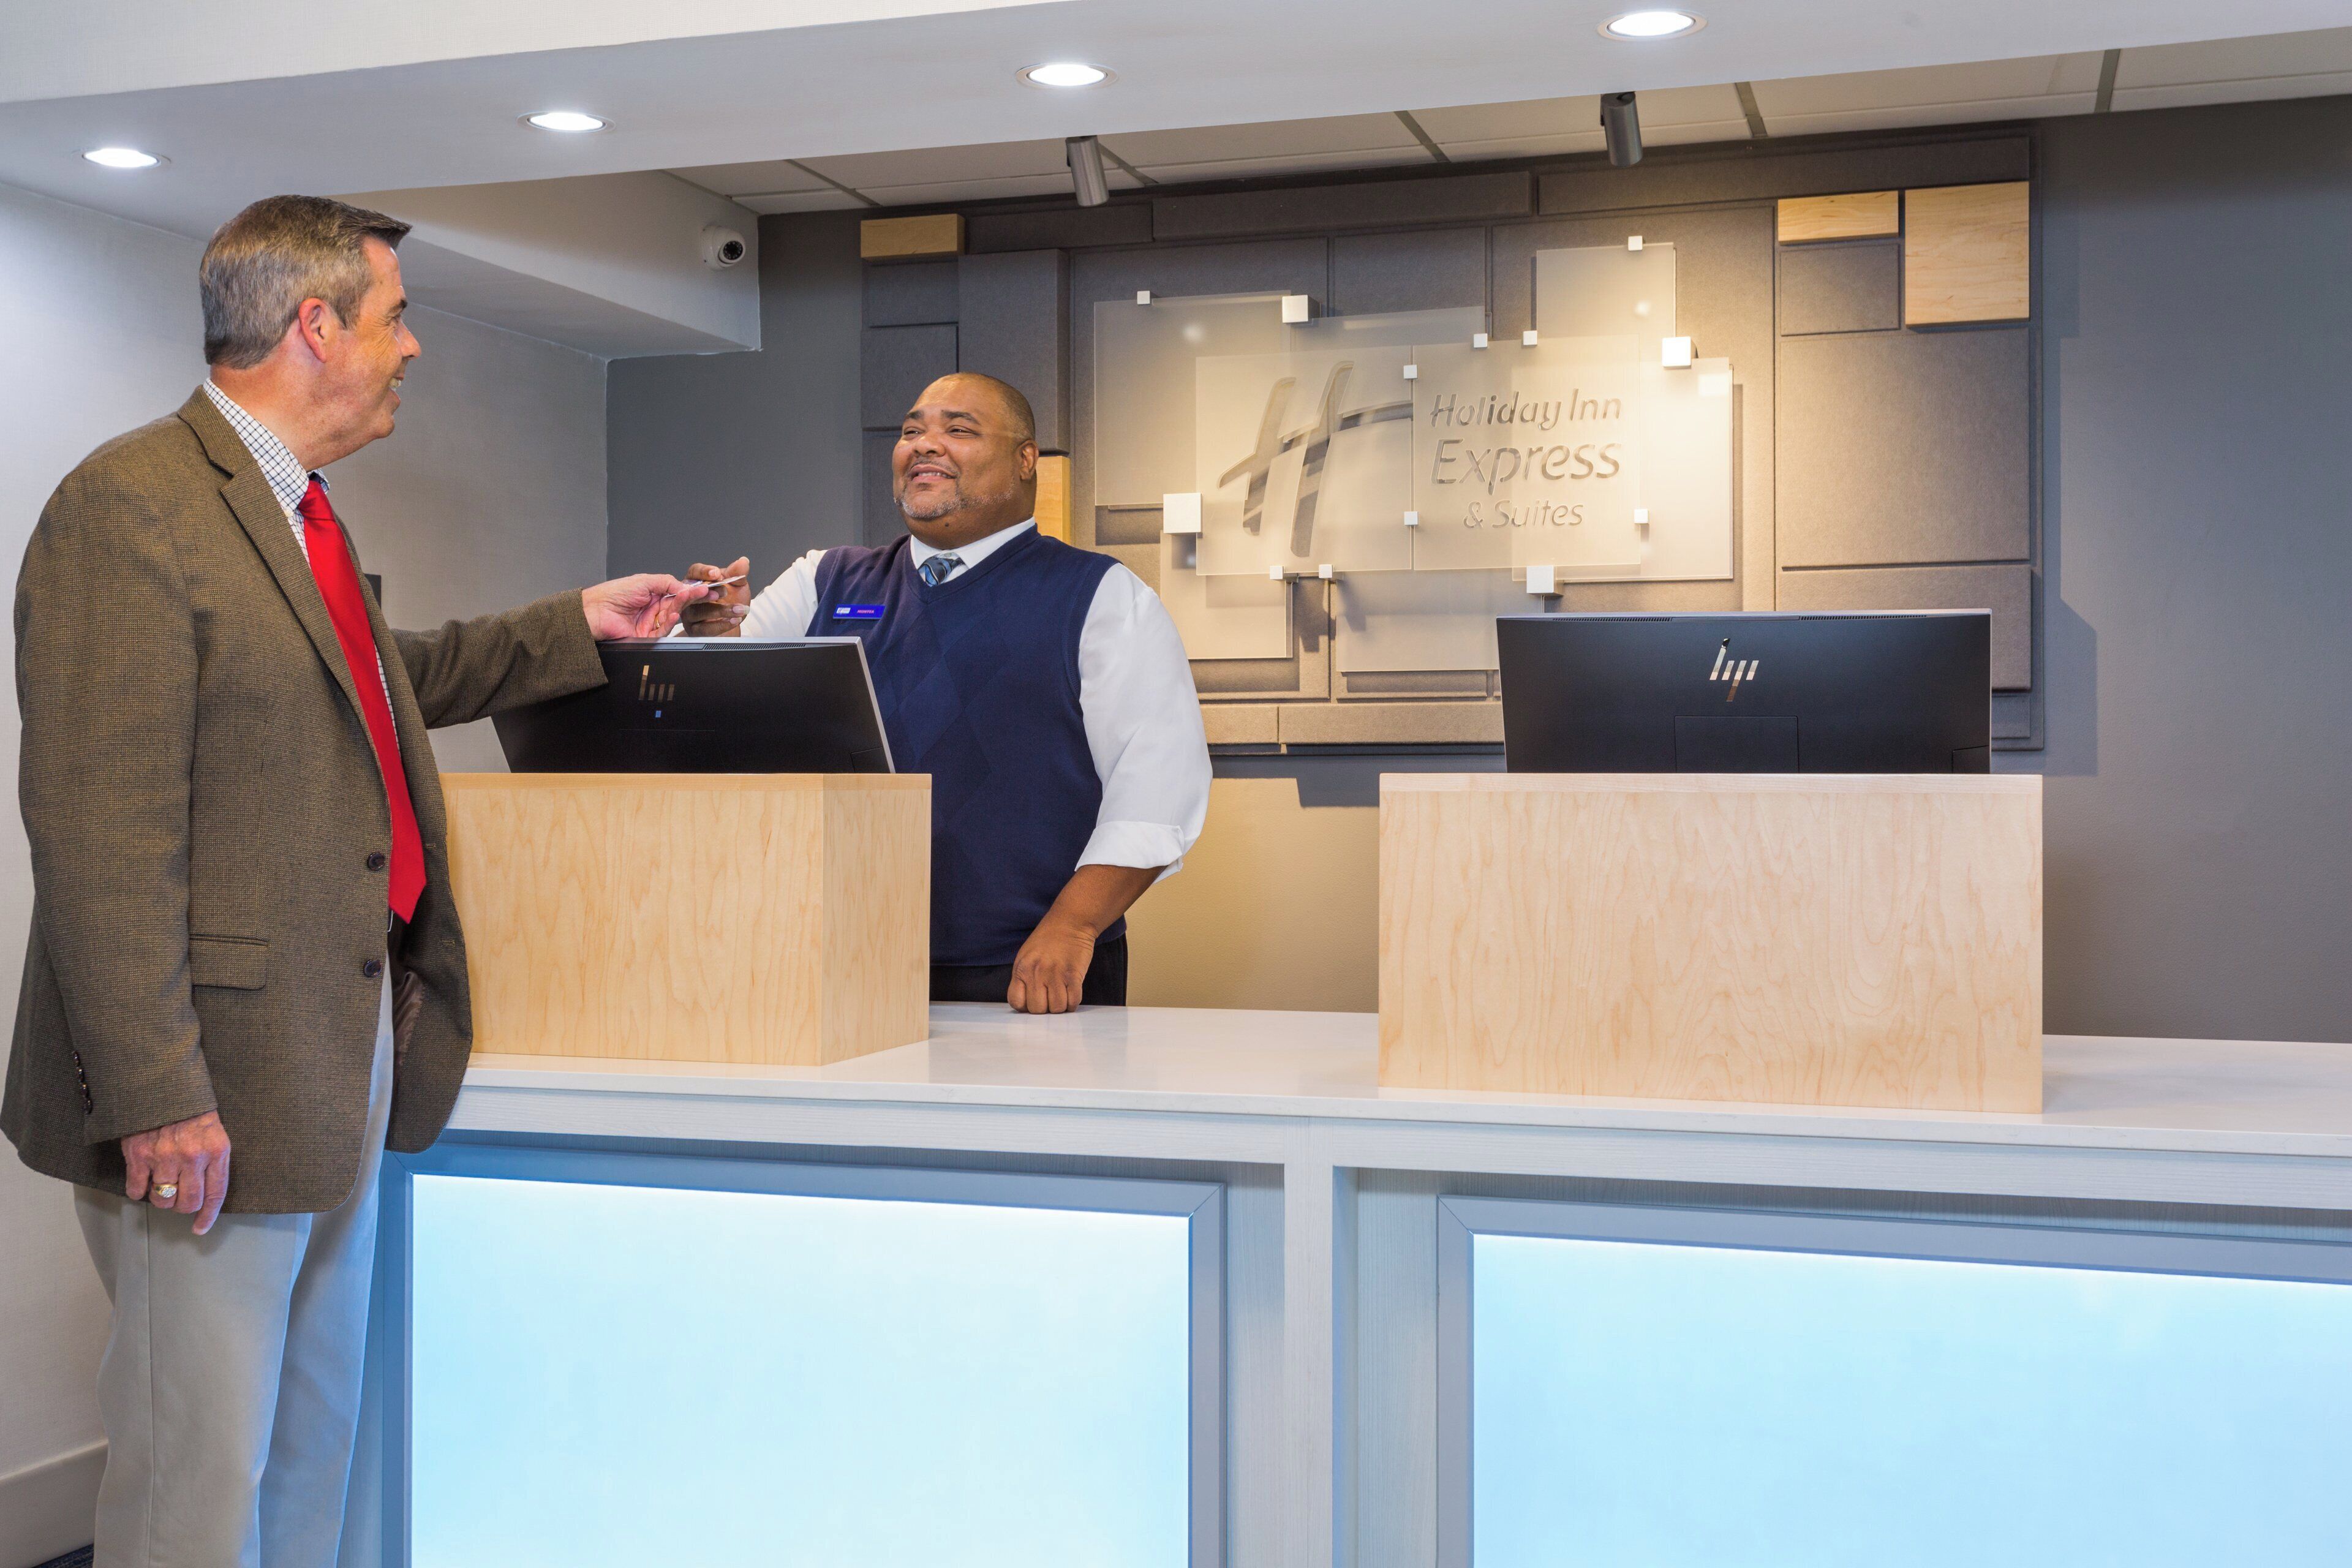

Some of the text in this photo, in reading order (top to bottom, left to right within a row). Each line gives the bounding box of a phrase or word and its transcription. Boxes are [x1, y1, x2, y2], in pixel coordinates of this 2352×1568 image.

[1430, 388, 1622, 431] Holiday Inn
[1431, 438, 1622, 496] Express
[1463, 499, 1584, 529] & Suites
[1709, 638, 1759, 702] hp
